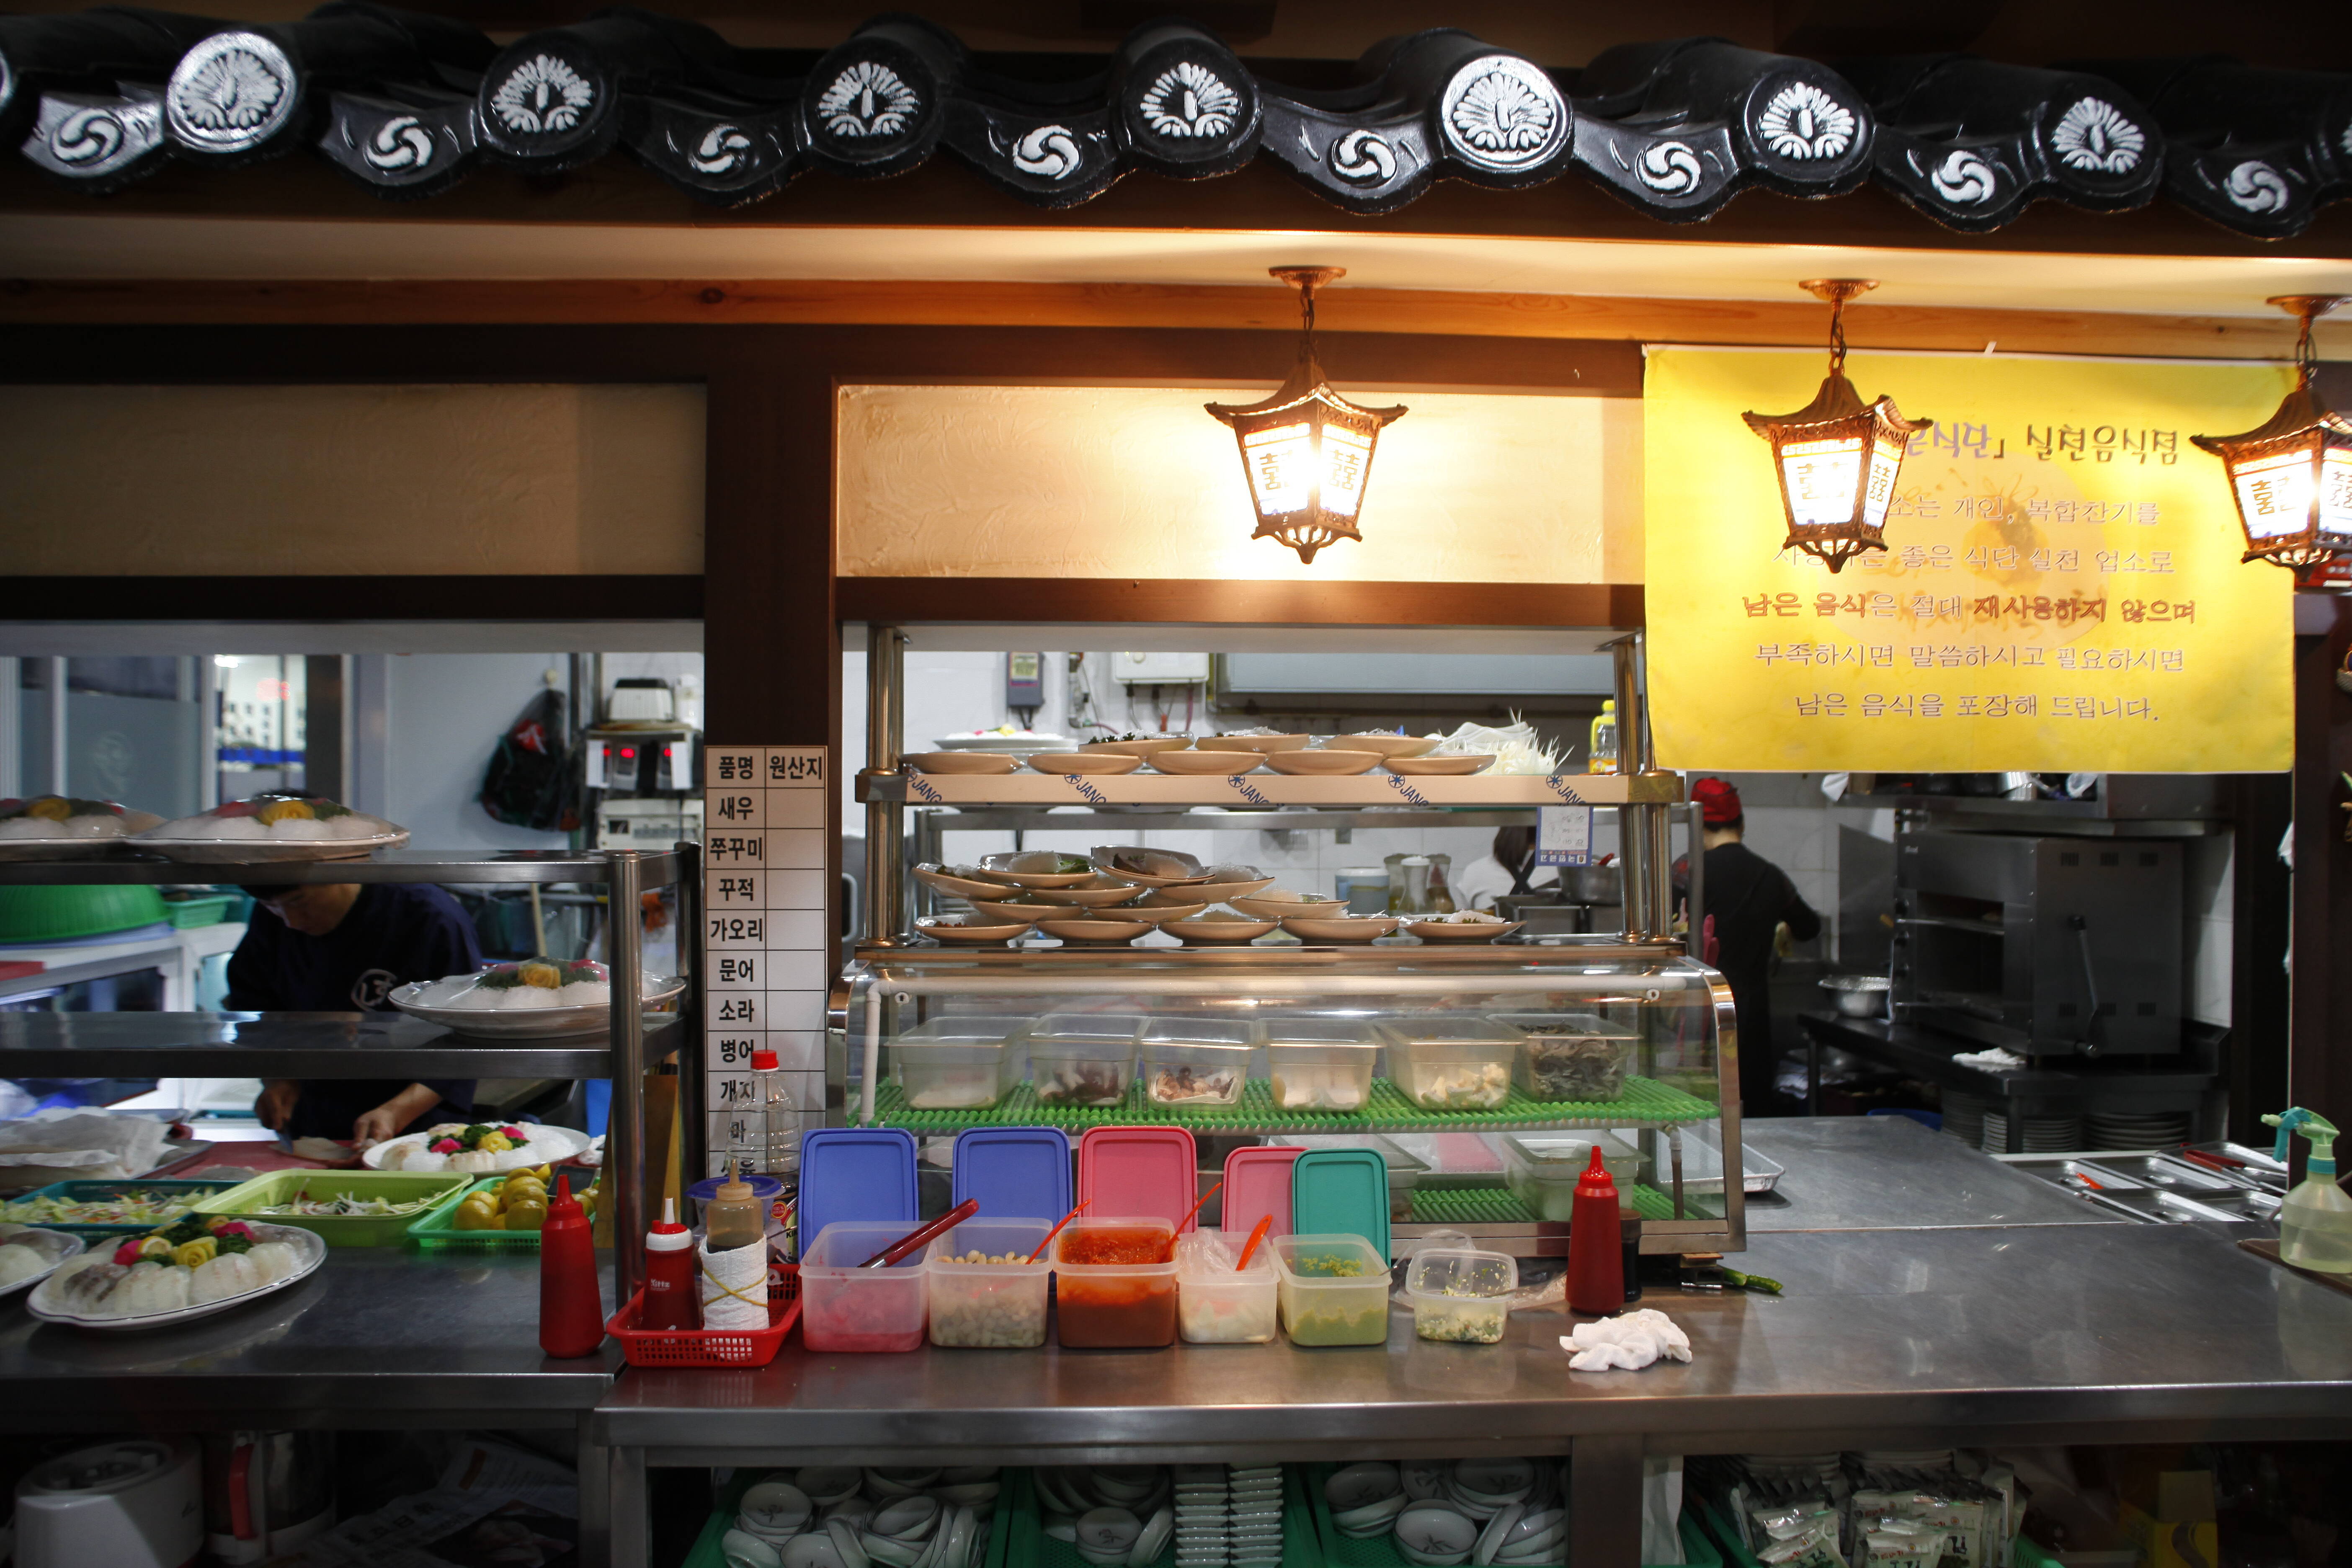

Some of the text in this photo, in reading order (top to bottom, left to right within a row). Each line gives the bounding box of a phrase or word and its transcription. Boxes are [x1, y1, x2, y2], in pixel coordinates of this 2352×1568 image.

[1953, 496, 2014, 524] 개인,
[2025, 498, 2160, 526] 복합찬기를
[1901, 544, 1953, 568] 좋은
[1965, 546, 2020, 570] 식단
[2030, 547, 2080, 571] 실천
[2096, 549, 2175, 574] 업소로
[1743, 592, 2196, 624] 남은 음식은 절대 재사용하지 않으며
[1754, 643, 2184, 672] 부족하시면 말씀하시고 필요하시면
[1795, 692, 2159, 721] 남은 음식을 포장해 드립니다.
[719, 756, 822, 780] 품명 원산지
[718, 797, 753, 820] 새우
[710, 837, 762, 861] 쭈꾸미
[719, 878, 753, 901] 꾸적
[710, 918, 762, 941] 가오리
[720, 959, 753, 982] 문어
[719, 999, 754, 1023] 소라
[721, 1039, 754, 1063] 병어
